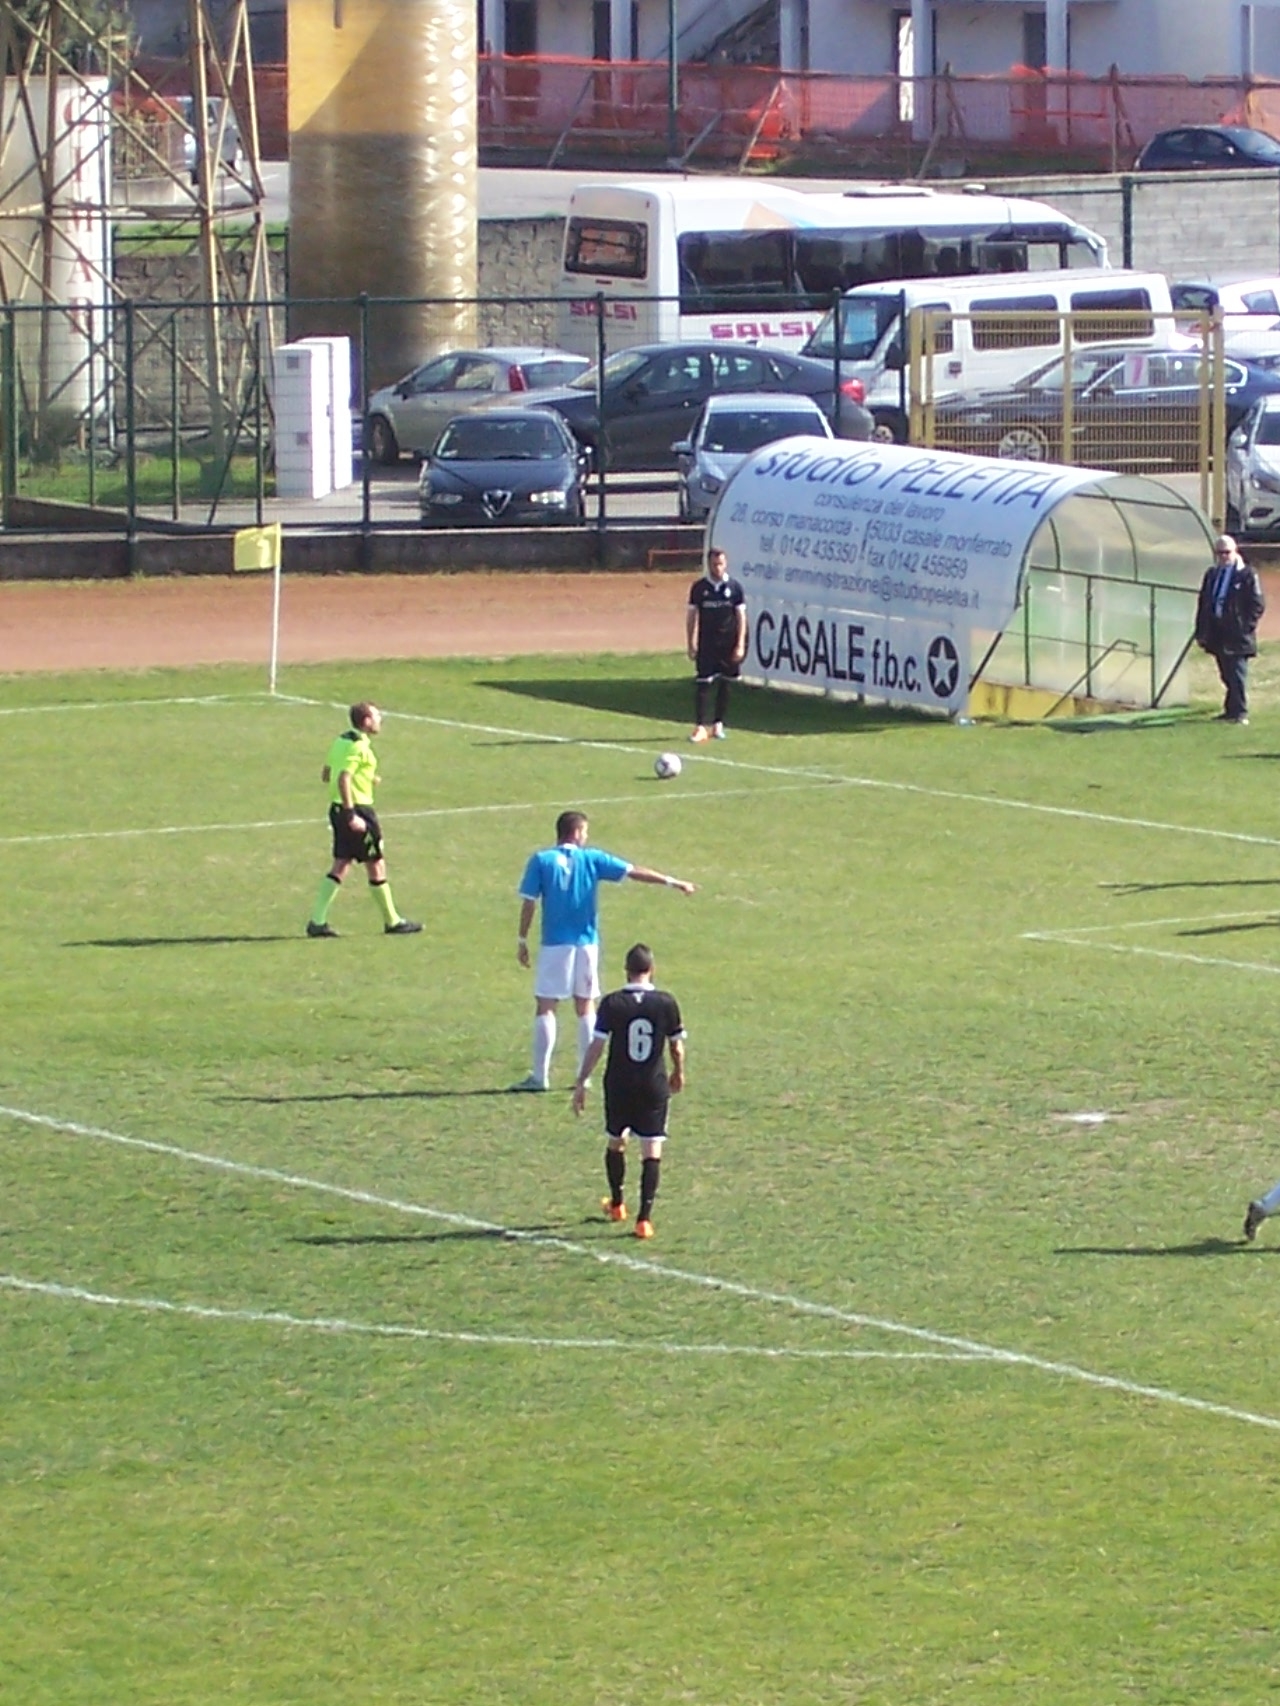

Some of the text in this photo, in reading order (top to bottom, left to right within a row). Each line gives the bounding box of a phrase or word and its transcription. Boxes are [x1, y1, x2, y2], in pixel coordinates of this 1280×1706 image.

[709, 321, 817, 339] SALSI
[754, 448, 1068, 509] studio PELETTA
[779, 534, 811, 559] 0142
[886, 549, 920, 573] 0142
[756, 610, 922, 693] CASALE f.b.c.
[627, 1018, 654, 1063] 6
